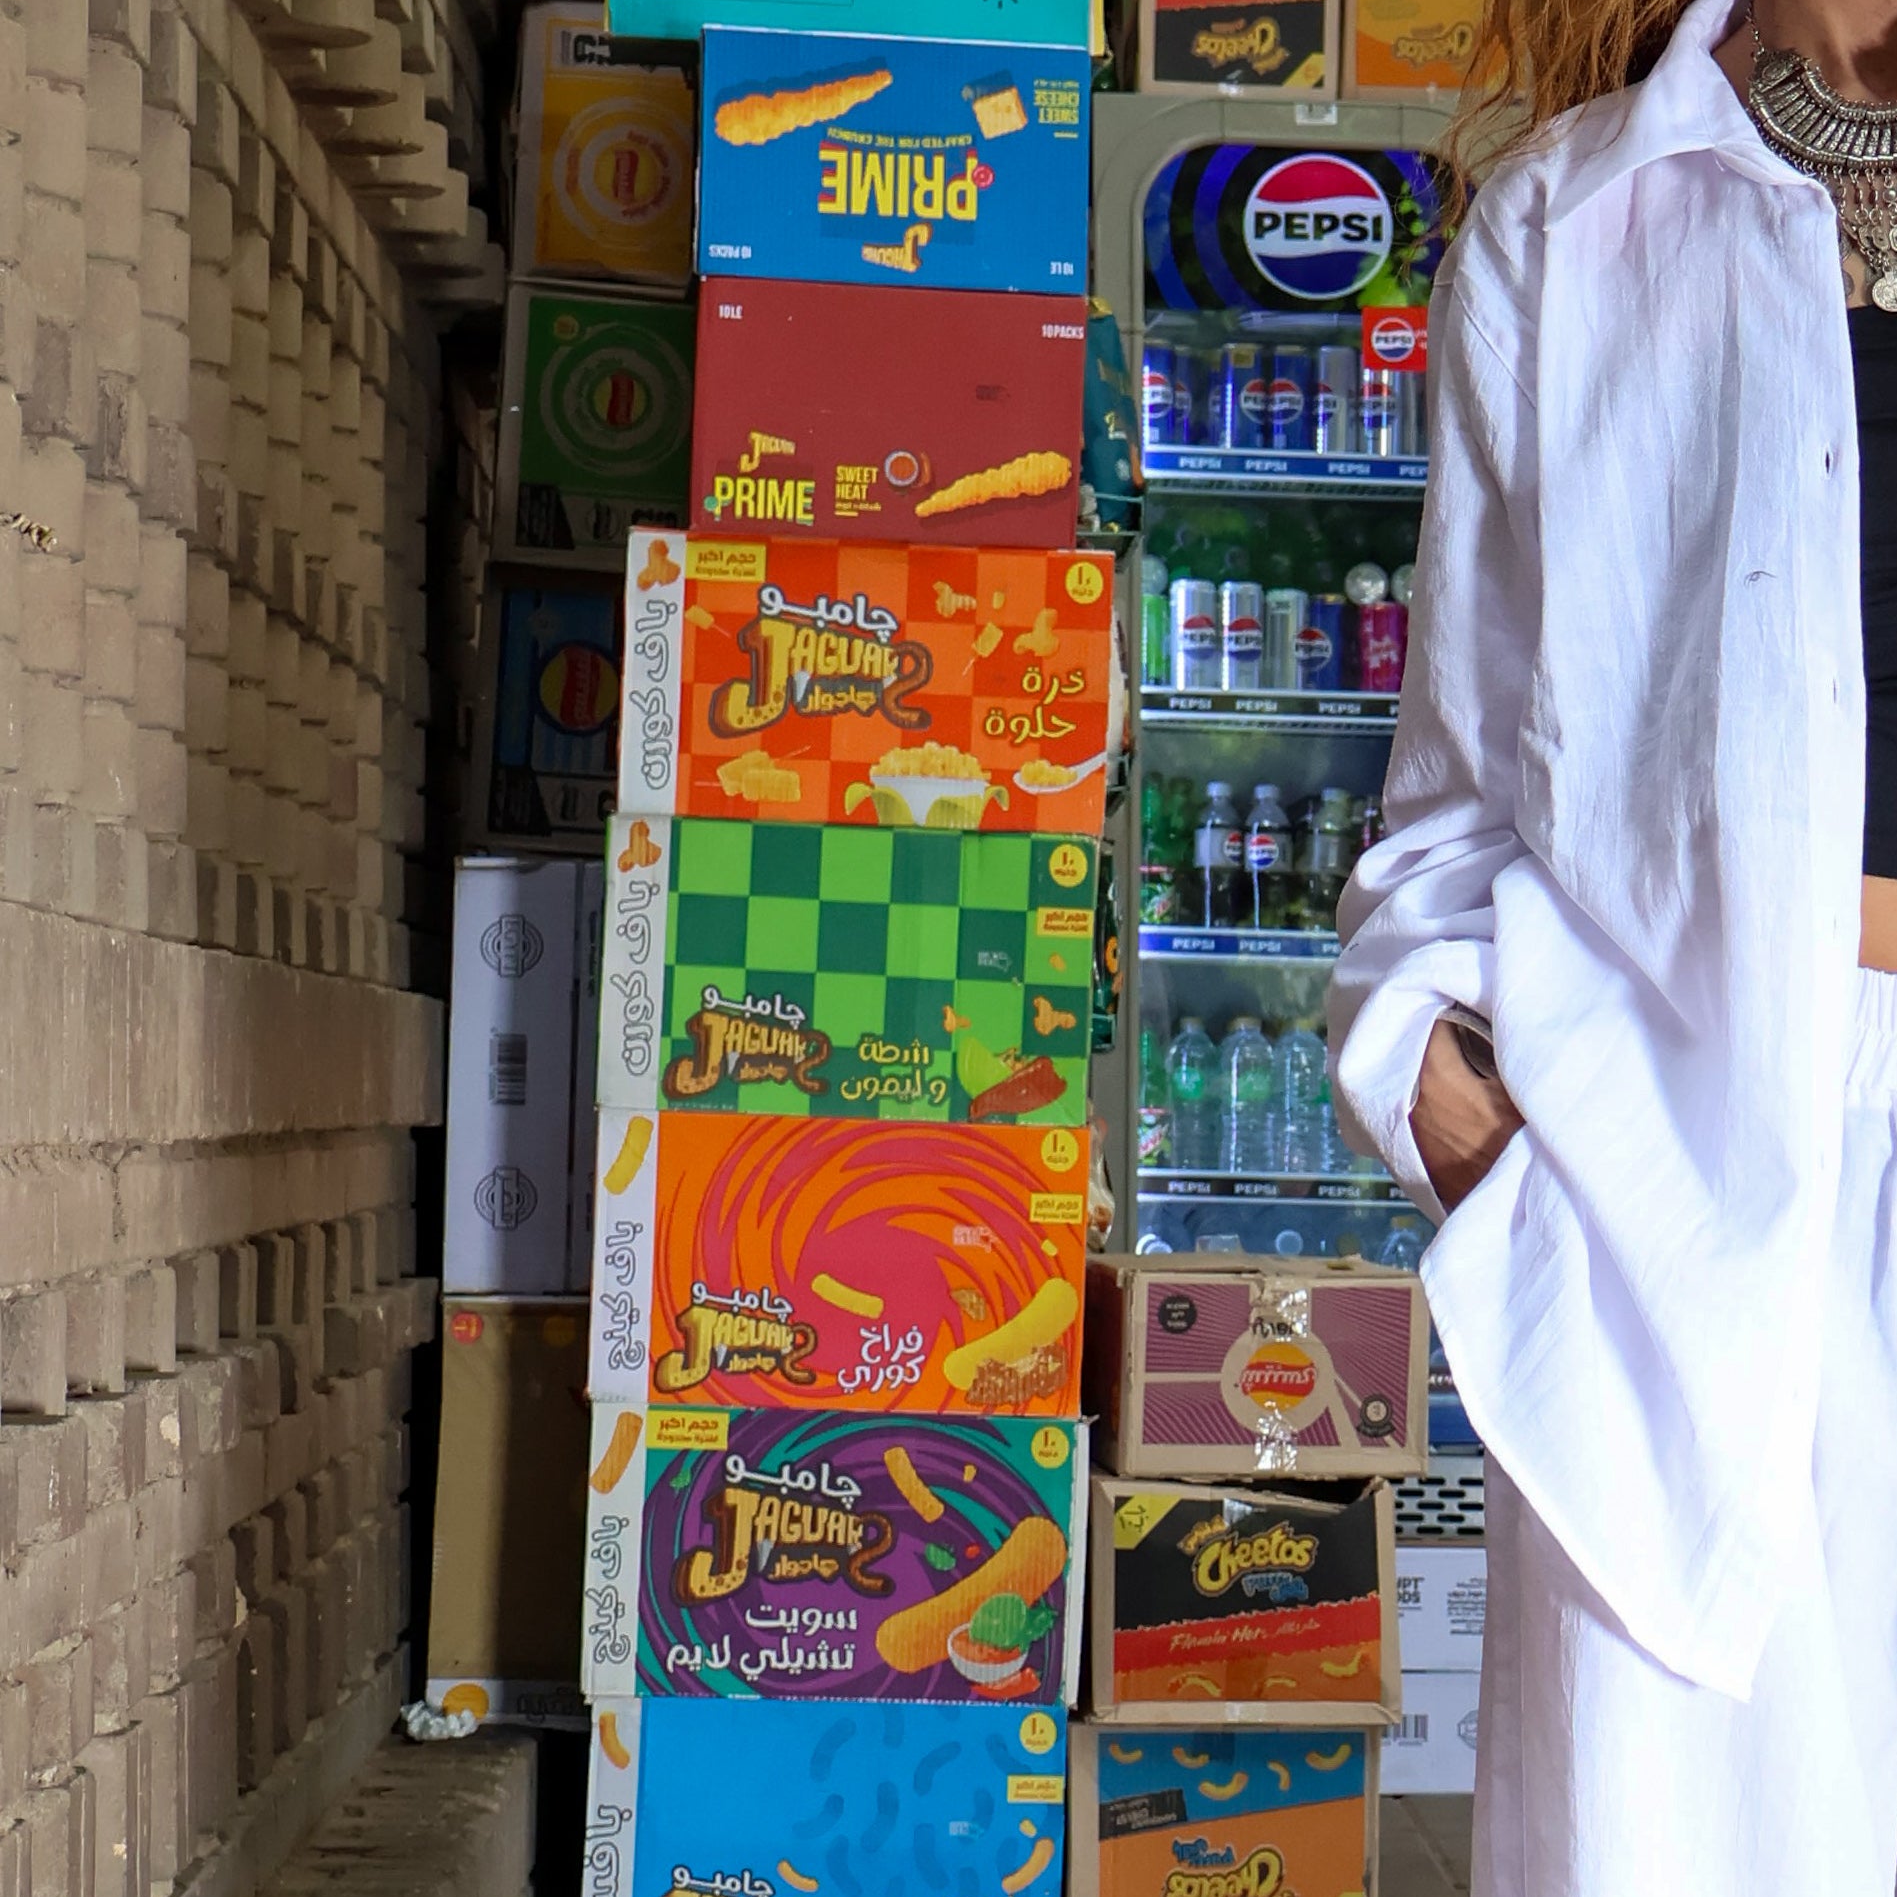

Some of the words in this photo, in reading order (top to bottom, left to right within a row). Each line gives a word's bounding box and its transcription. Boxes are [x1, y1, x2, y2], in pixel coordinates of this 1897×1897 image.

[876, 135, 895, 148] THE
[898, 136, 921, 149] FOR
[922, 133, 972, 148] CRAFTED
[818, 142, 978, 221] PRIME
[1253, 210, 1384, 243] PEPSI
[708, 245, 739, 258] PACKS
[836, 465, 878, 484] SWEET
[1179, 457, 1222, 469] PEPSI
[1245, 459, 1288, 472] PEPSI
[1328, 462, 1370, 475] PEPSI
[713, 475, 816, 525] PRIME
[836, 483, 869, 502] HEAT
[726, 551, 757, 566] حجم
[709, 616, 933, 739] JAGUAR
[1169, 697, 1212, 710] PEPSI
[1235, 699, 1278, 712] PEPSI
[1319, 702, 1362, 714] PEPSI
[985, 709, 1077, 744] حلوة
[1172, 938, 1215, 950] PEPSI
[1239, 939, 1282, 952] PEPSI
[663, 1009, 832, 1101] JAGUAR
[840, 1067, 924, 1103] ليمون
[1168, 1181, 1211, 1194] PEPSI
[1318, 1185, 1361, 1198] PEPSI
[654, 1305, 818, 1394] JAGUAR
[859, 1323, 925, 1357] فراخ
[837, 1357, 926, 1394] كوري
[687, 1420, 720, 1433] حجم
[672, 1486, 895, 1609] JAGUAR
[1195, 1524, 1317, 1596] Cheetos
[745, 1606, 858, 1636] سويت
[666, 1636, 731, 1673] لايم
[740, 1640, 856, 1682] تشيلي
